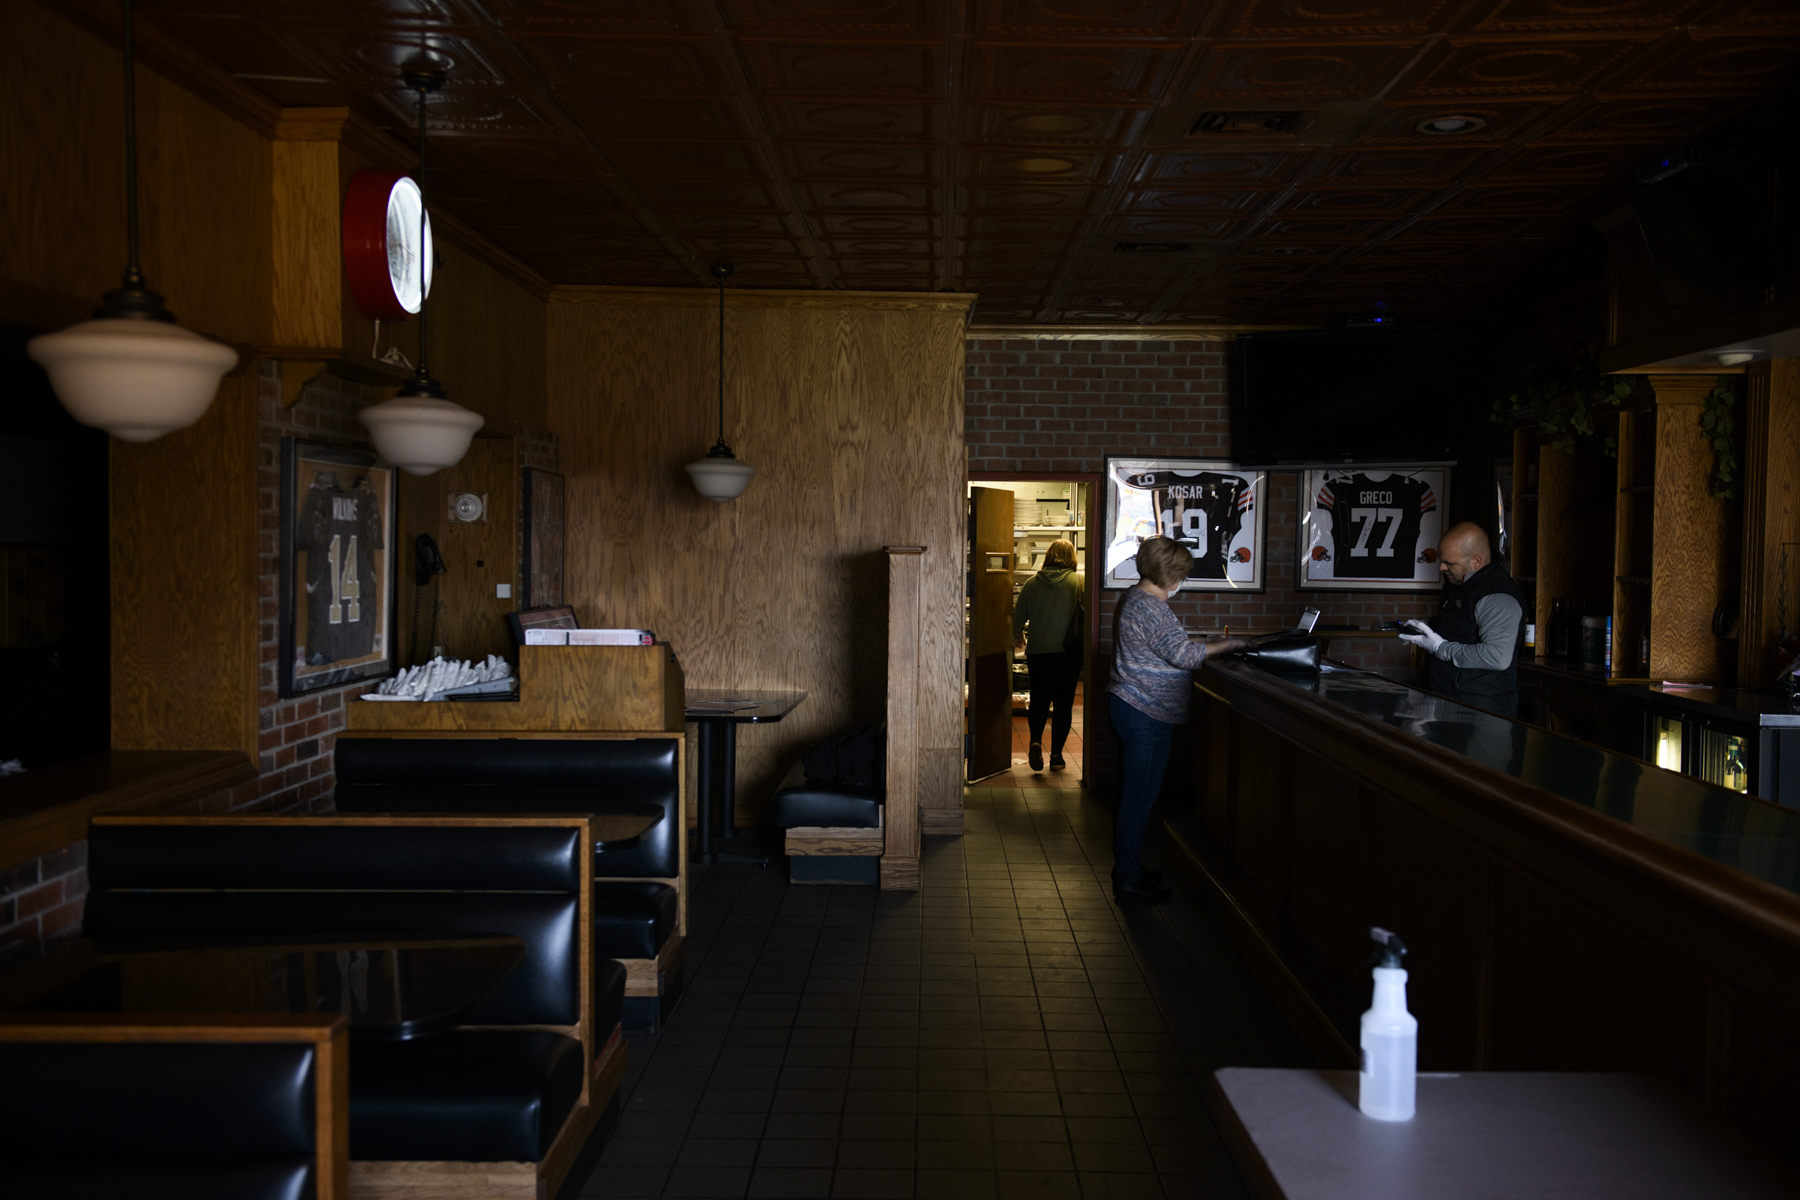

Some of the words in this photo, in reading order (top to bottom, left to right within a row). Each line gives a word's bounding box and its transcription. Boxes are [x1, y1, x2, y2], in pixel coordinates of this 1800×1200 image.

[1168, 485, 1203, 499] KOSAR
[1359, 491, 1393, 505] GRECO
[1160, 508, 1208, 558] 19
[1350, 507, 1403, 558] 77
[328, 534, 360, 625] 14
